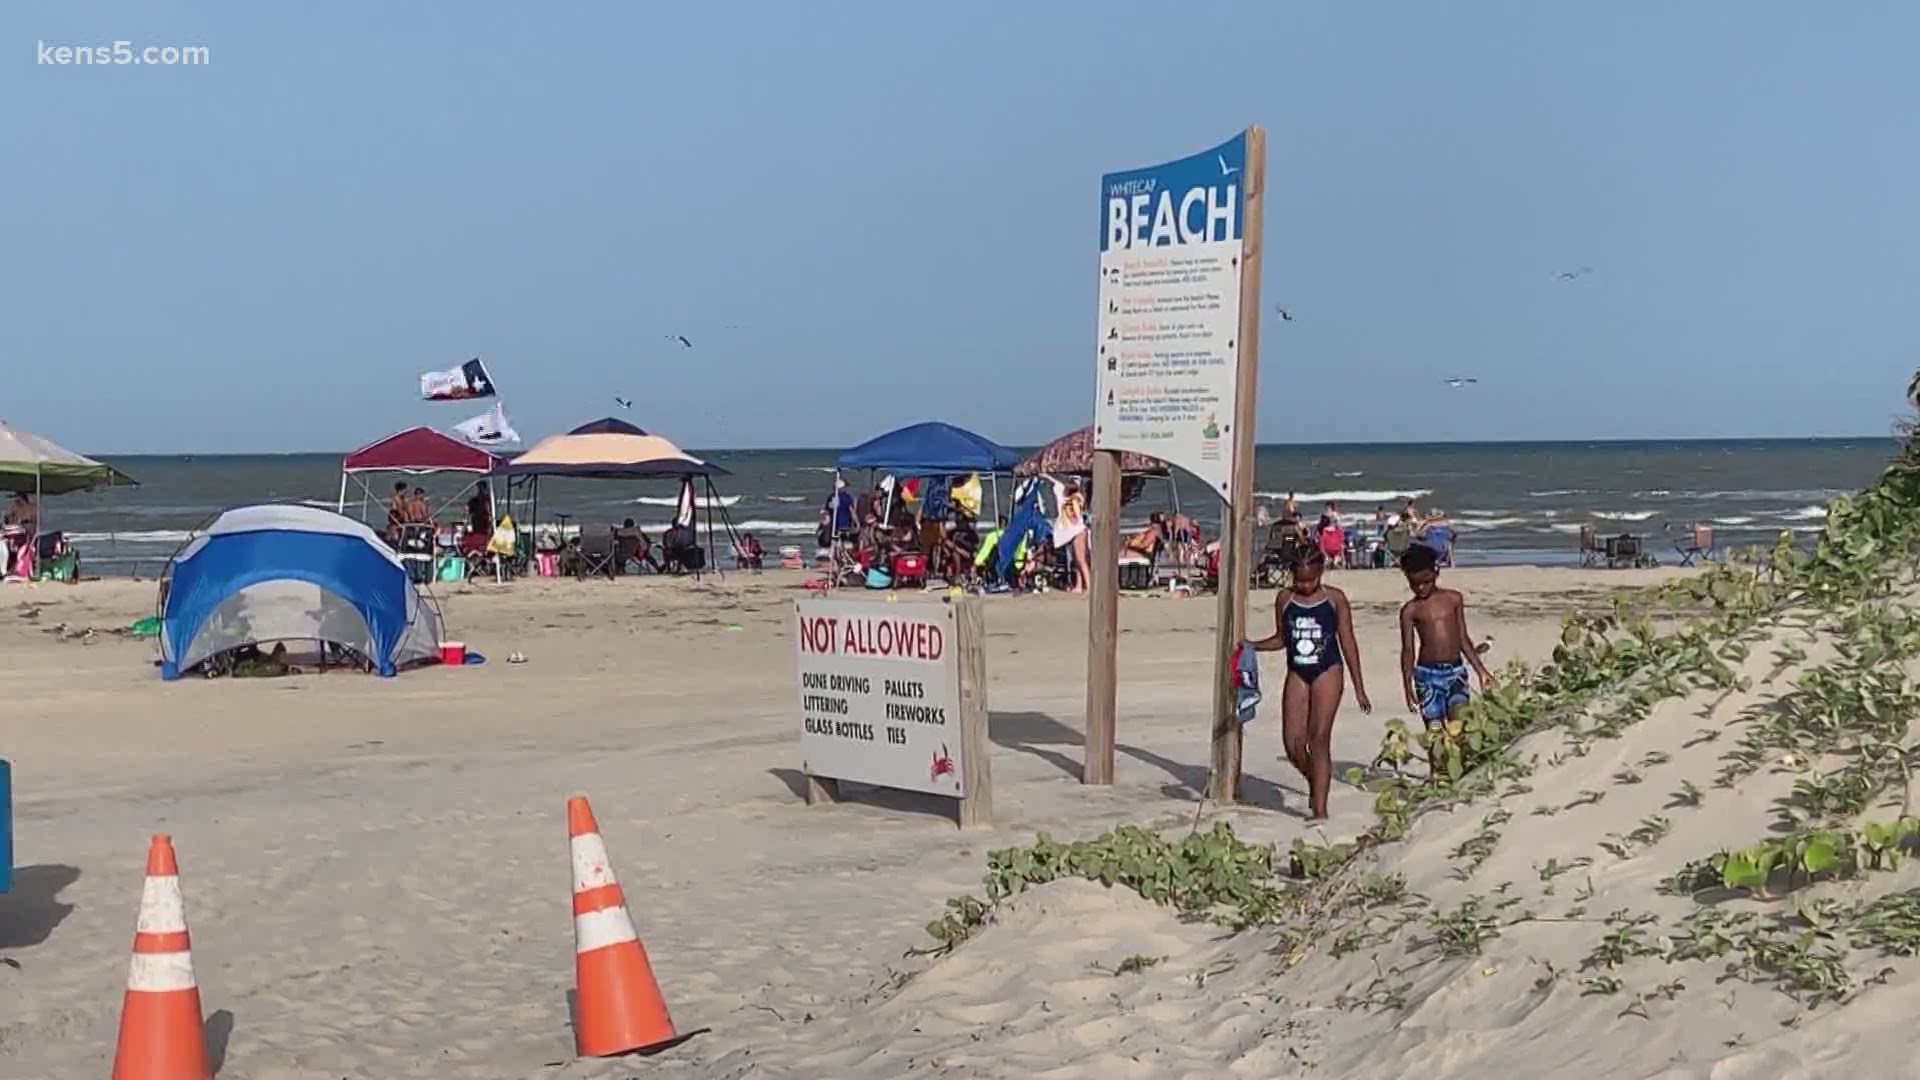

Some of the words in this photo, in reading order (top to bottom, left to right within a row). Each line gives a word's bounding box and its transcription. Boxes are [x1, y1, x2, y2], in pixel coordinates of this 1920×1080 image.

[1108, 185, 1237, 250] BEACH
[800, 616, 838, 655] NOT
[843, 619, 943, 661] ALLOWED
[803, 672, 828, 691] DUNE
[830, 674, 870, 695] DRIVING
[884, 680, 925, 699] PALLETS
[803, 695, 849, 715] LITTERING
[886, 703, 946, 725] FIREWORKS
[804, 717, 834, 735] GLASS
[835, 721, 875, 741] BOTTLES
[886, 727, 907, 745] TIES
